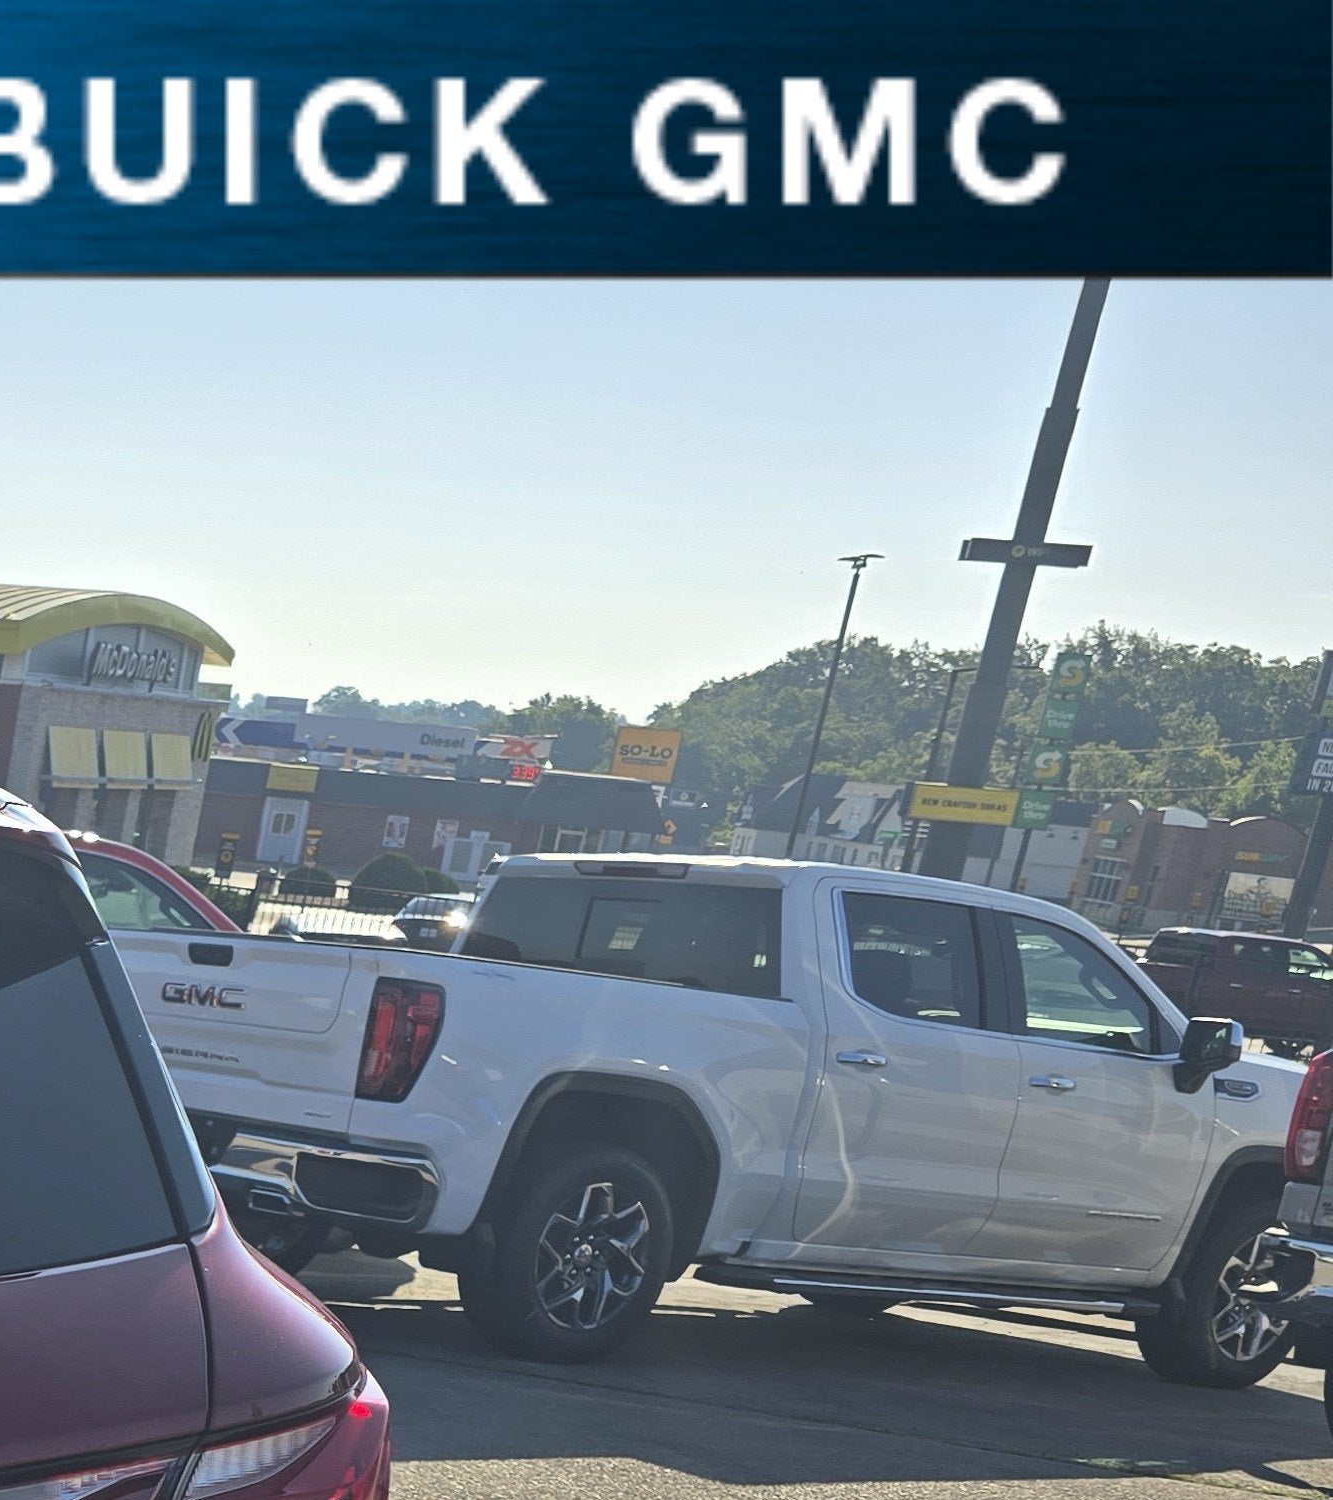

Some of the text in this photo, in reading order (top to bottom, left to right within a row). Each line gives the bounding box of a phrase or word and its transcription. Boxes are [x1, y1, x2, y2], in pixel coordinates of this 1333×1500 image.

[92, 642, 177, 682] McDonald's
[420, 733, 465, 749] Diesel
[619, 744, 673, 760] SO-LO
[1306, 778, 1321, 791] IN
[162, 981, 245, 1010] GMC
